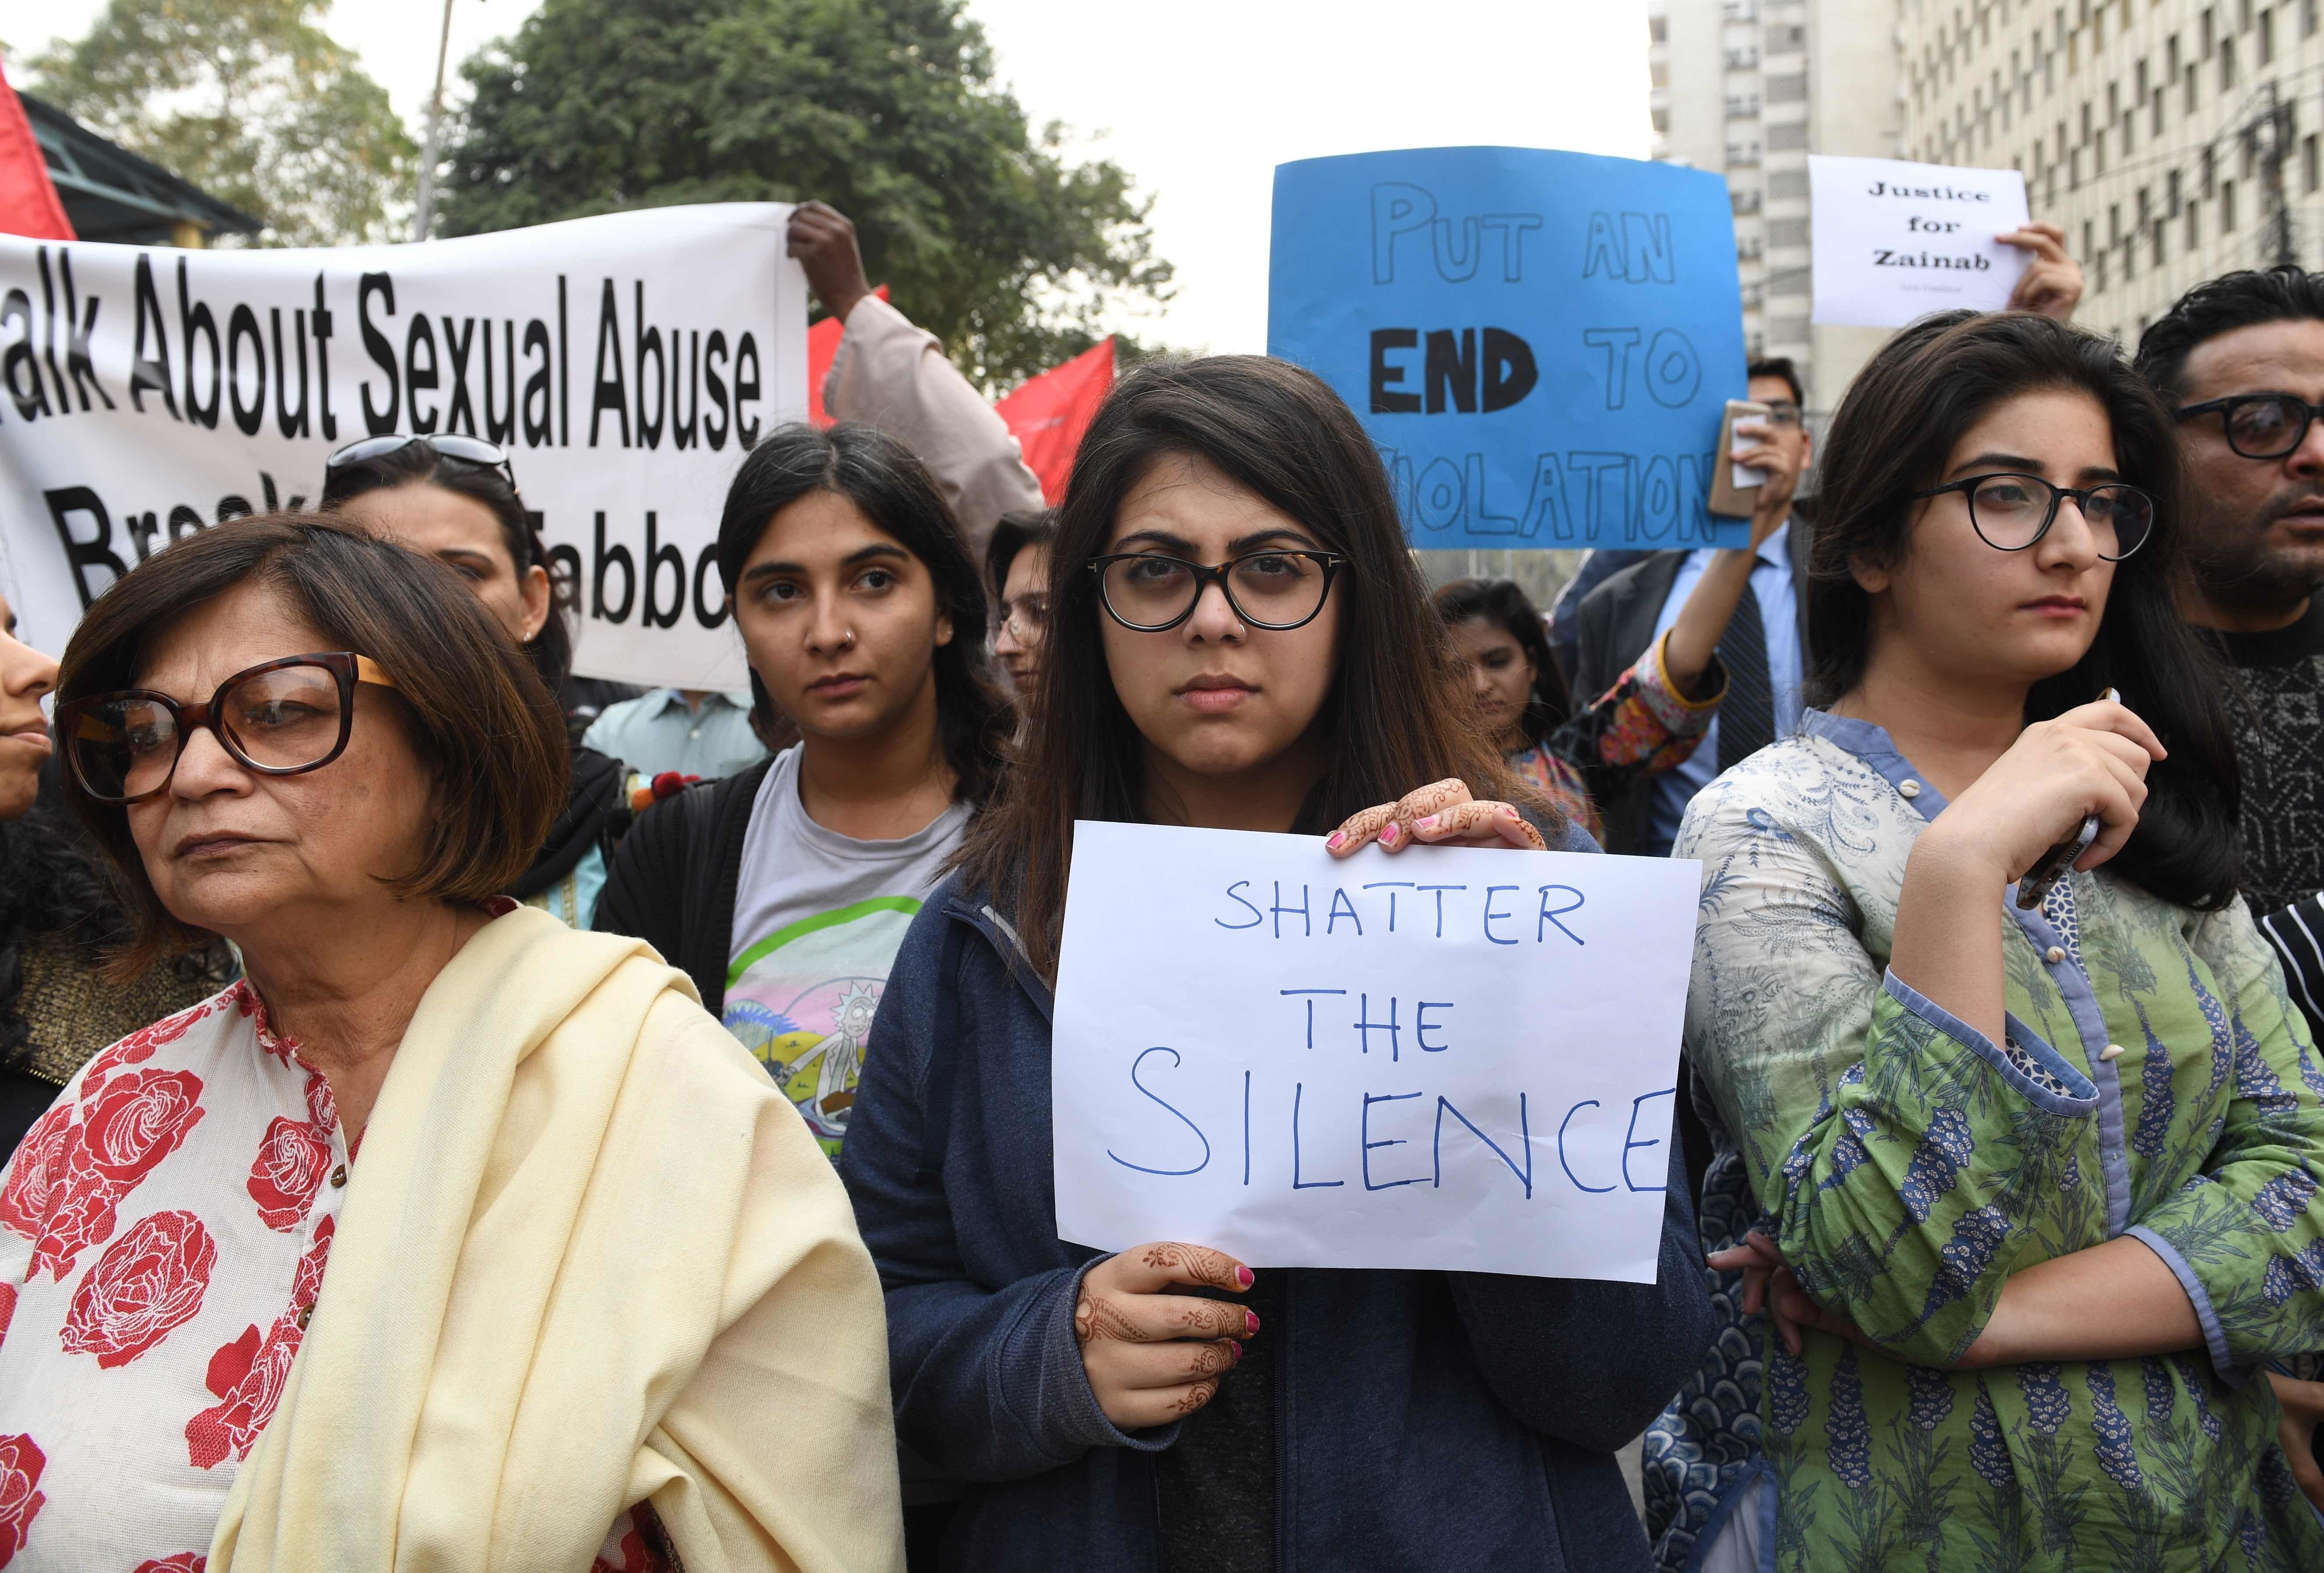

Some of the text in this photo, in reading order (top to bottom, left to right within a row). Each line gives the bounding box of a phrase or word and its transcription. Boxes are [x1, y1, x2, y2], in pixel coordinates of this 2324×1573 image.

[1868, 181, 1991, 202] Justice
[1908, 217, 1962, 233] for
[1370, 182, 1675, 285] PUT AN
[1873, 249, 1991, 271] Zainab
[0, 245, 760, 452] alk About Sexual Abuse
[1369, 327, 1702, 414] END TO
[1376, 447, 1718, 543] IOLATION
[1214, 880, 1585, 946] SHATTER
[1280, 988, 1455, 1062] THE
[1106, 1046, 1676, 1200] SILENCE
